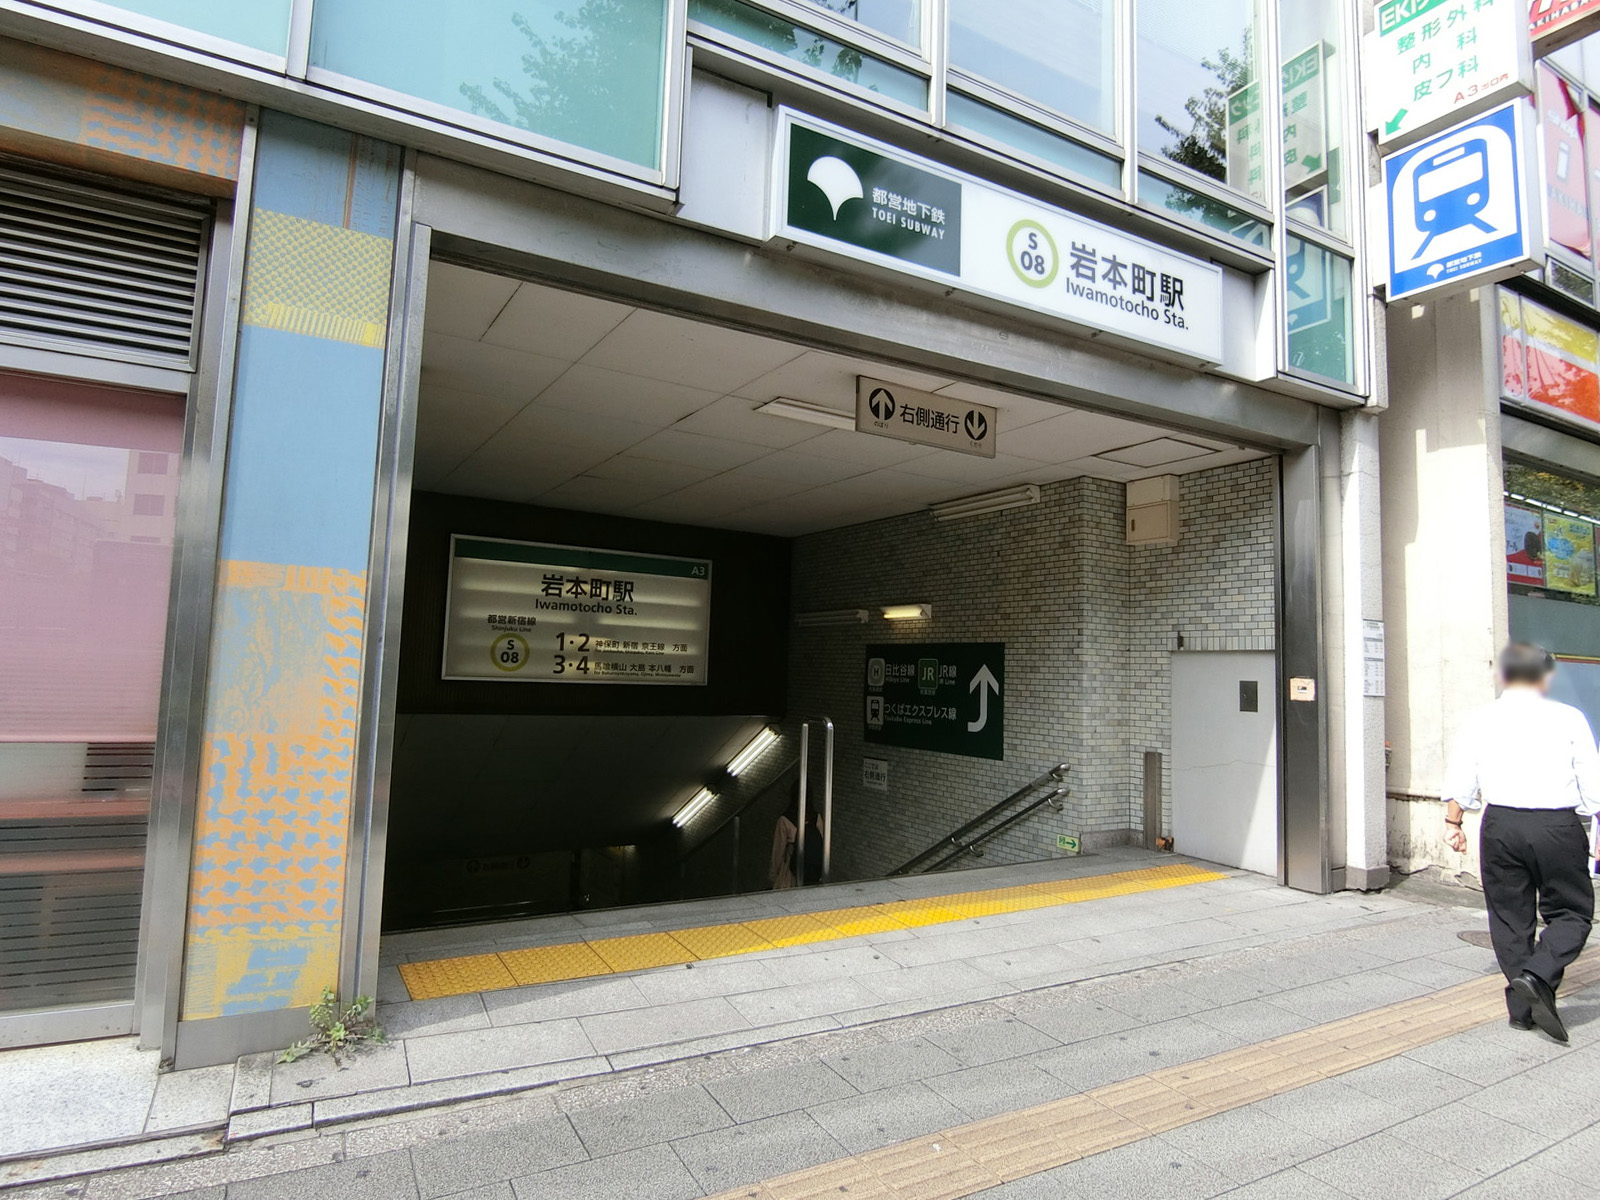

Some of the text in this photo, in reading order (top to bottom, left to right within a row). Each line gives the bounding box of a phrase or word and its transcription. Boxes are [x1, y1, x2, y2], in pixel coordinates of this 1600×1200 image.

[1414, 55, 1479, 102] 皮フ科
[872, 187, 946, 226] 都営地下鉄
[872, 207, 946, 240] TOEI SUBWAY
[1028, 232, 1038, 250] S
[1020, 250, 1046, 276] 08
[1070, 241, 1184, 312] 岩本町駅
[1066, 278, 1188, 330] Iwamotocho Sta.
[900, 404, 960, 434] 右側通行
[692, 566, 705, 576] A3
[540, 574, 634, 602] 岩本町駅
[536, 598, 638, 616] Iwamotocho Sta.
[488, 614, 536, 626] 都営新宿線
[507, 640, 514, 650] S
[595, 640, 619, 649] 神保町
[623, 641, 638, 650] 新宿
[672, 644, 688, 652] 方面
[500, 652, 520, 664] 08
[679, 665, 694, 674] 方面
[873, 668, 879, 676] H
[886, 664, 915, 676] 日比谷線
[922, 667, 934, 680] JR
[939, 665, 957, 678] JR線
[884, 704, 957, 720] つくばエクスプレス線
